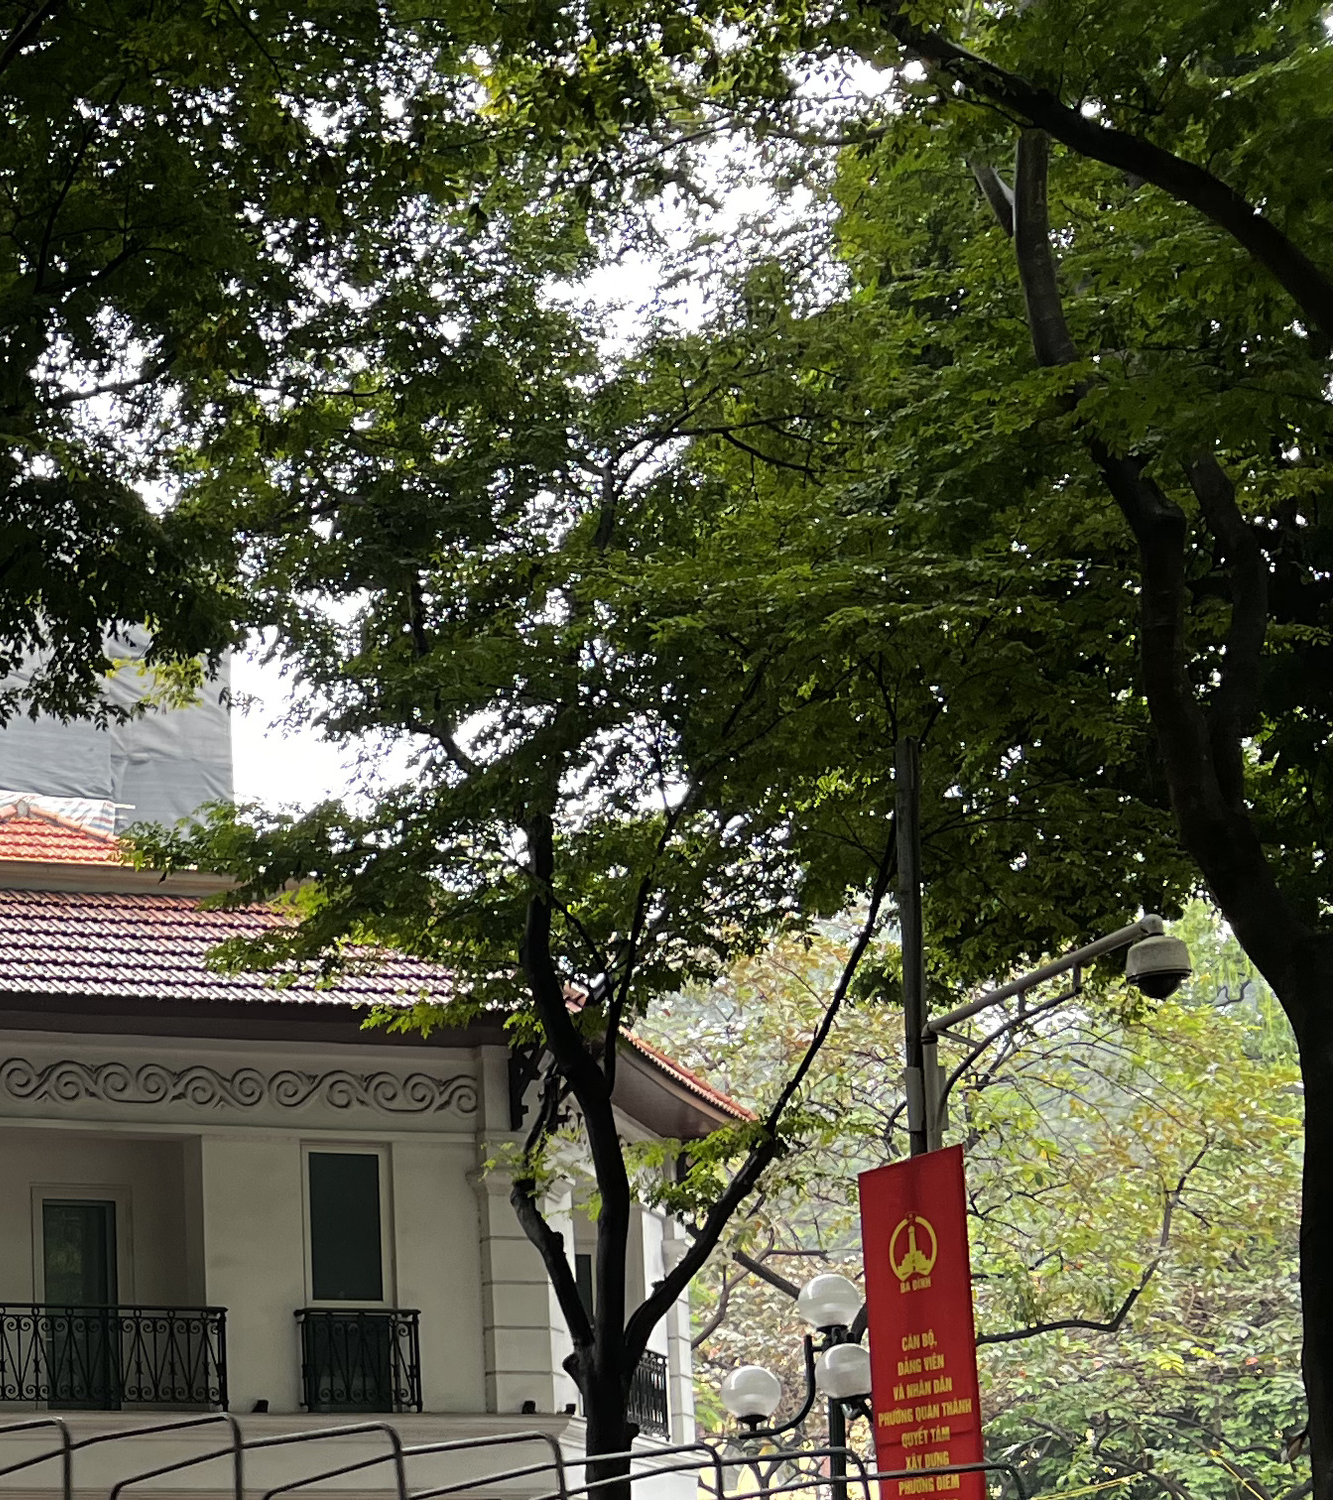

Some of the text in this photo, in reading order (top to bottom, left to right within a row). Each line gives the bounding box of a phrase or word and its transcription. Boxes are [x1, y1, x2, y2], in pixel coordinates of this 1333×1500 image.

[901, 1332, 920, 1351] CÁN
[923, 1351, 944, 1371] VIÊN
[893, 1375, 952, 1401] VÀ NHÂN DÂN
[878, 1407, 913, 1427] PHƯỜNG
